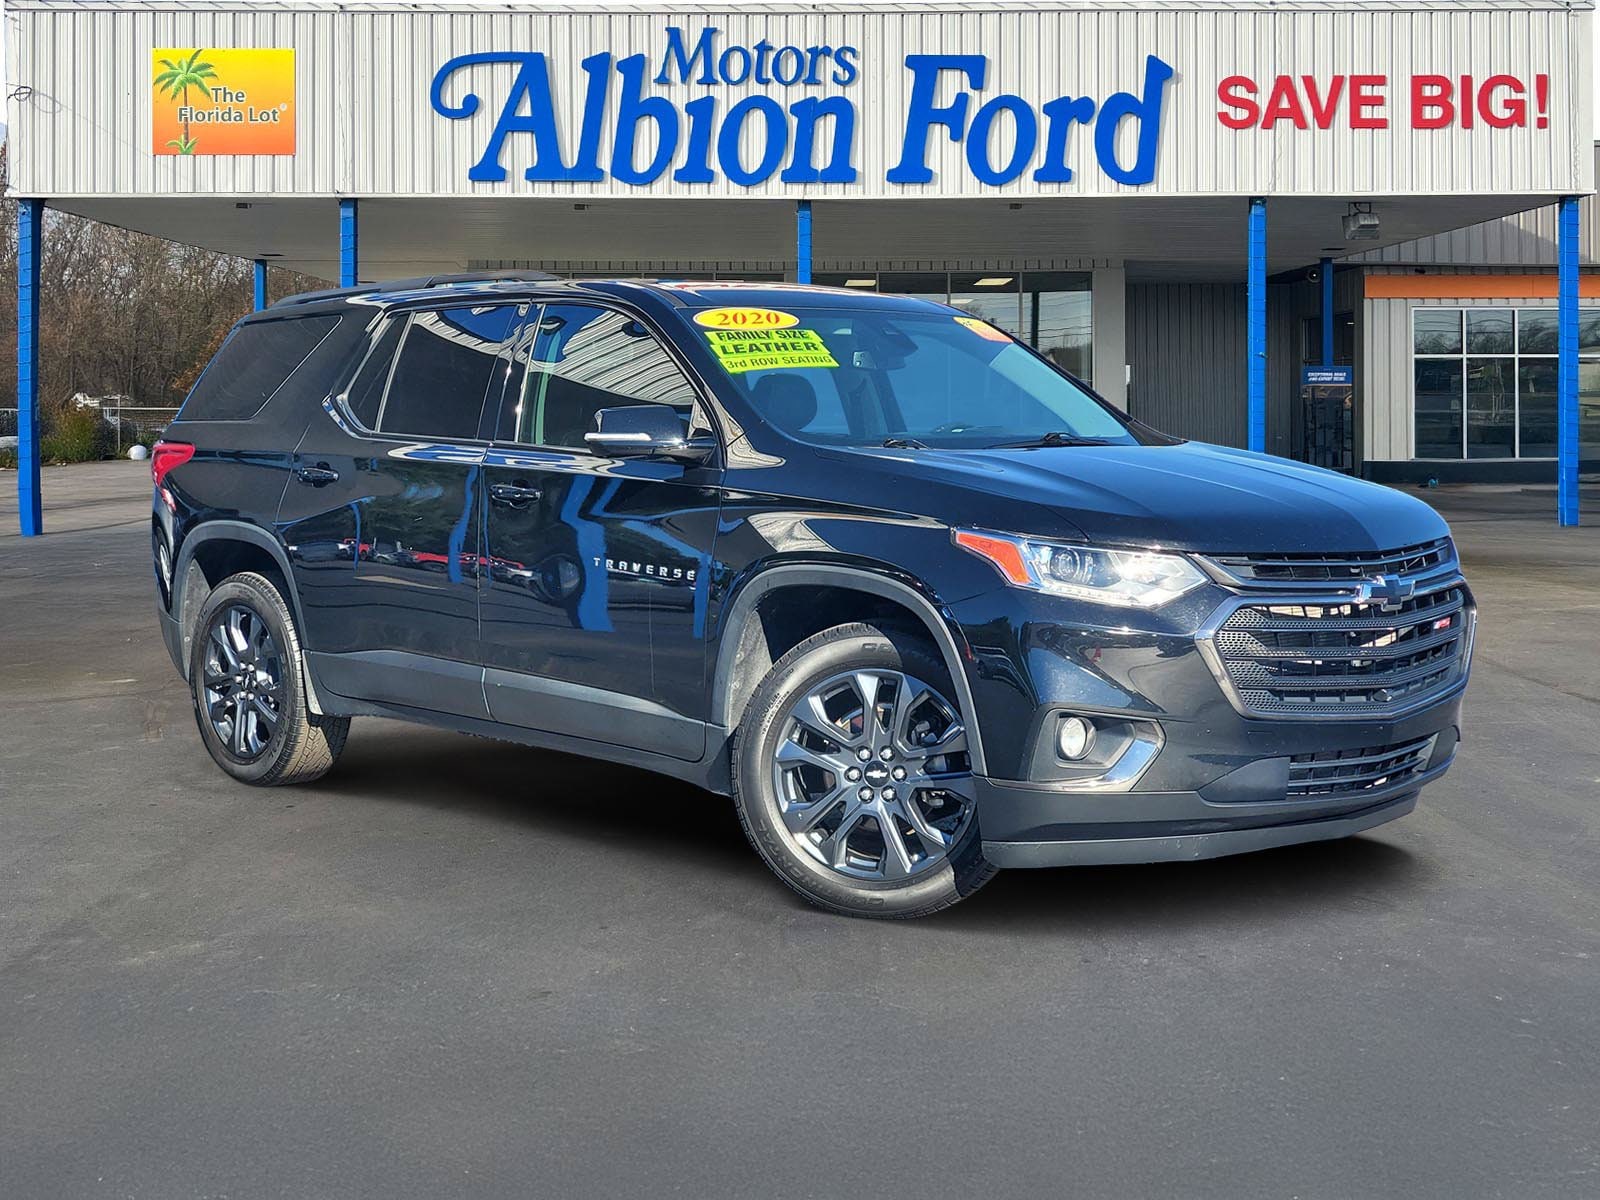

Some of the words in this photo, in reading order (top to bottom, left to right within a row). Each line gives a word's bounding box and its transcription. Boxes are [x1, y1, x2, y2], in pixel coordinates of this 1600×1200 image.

[653, 26, 857, 87] Motors
[211, 87, 245, 102] The
[1217, 74, 1389, 130] SAVE
[1411, 74, 1549, 130] BIG!
[178, 107, 243, 122] Florida
[430, 52, 858, 186] Albion
[886, 54, 1174, 186] Ford
[716, 312, 780, 325] 2020
[715, 330, 771, 342] FAMILY
[775, 330, 809, 339] SIZE
[720, 342, 819, 355] LEATHER
[726, 360, 747, 369] 3rd
[750, 357, 778, 367] ROW
[782, 355, 832, 365] SEATING
[593, 557, 696, 580] TRAVERSE
